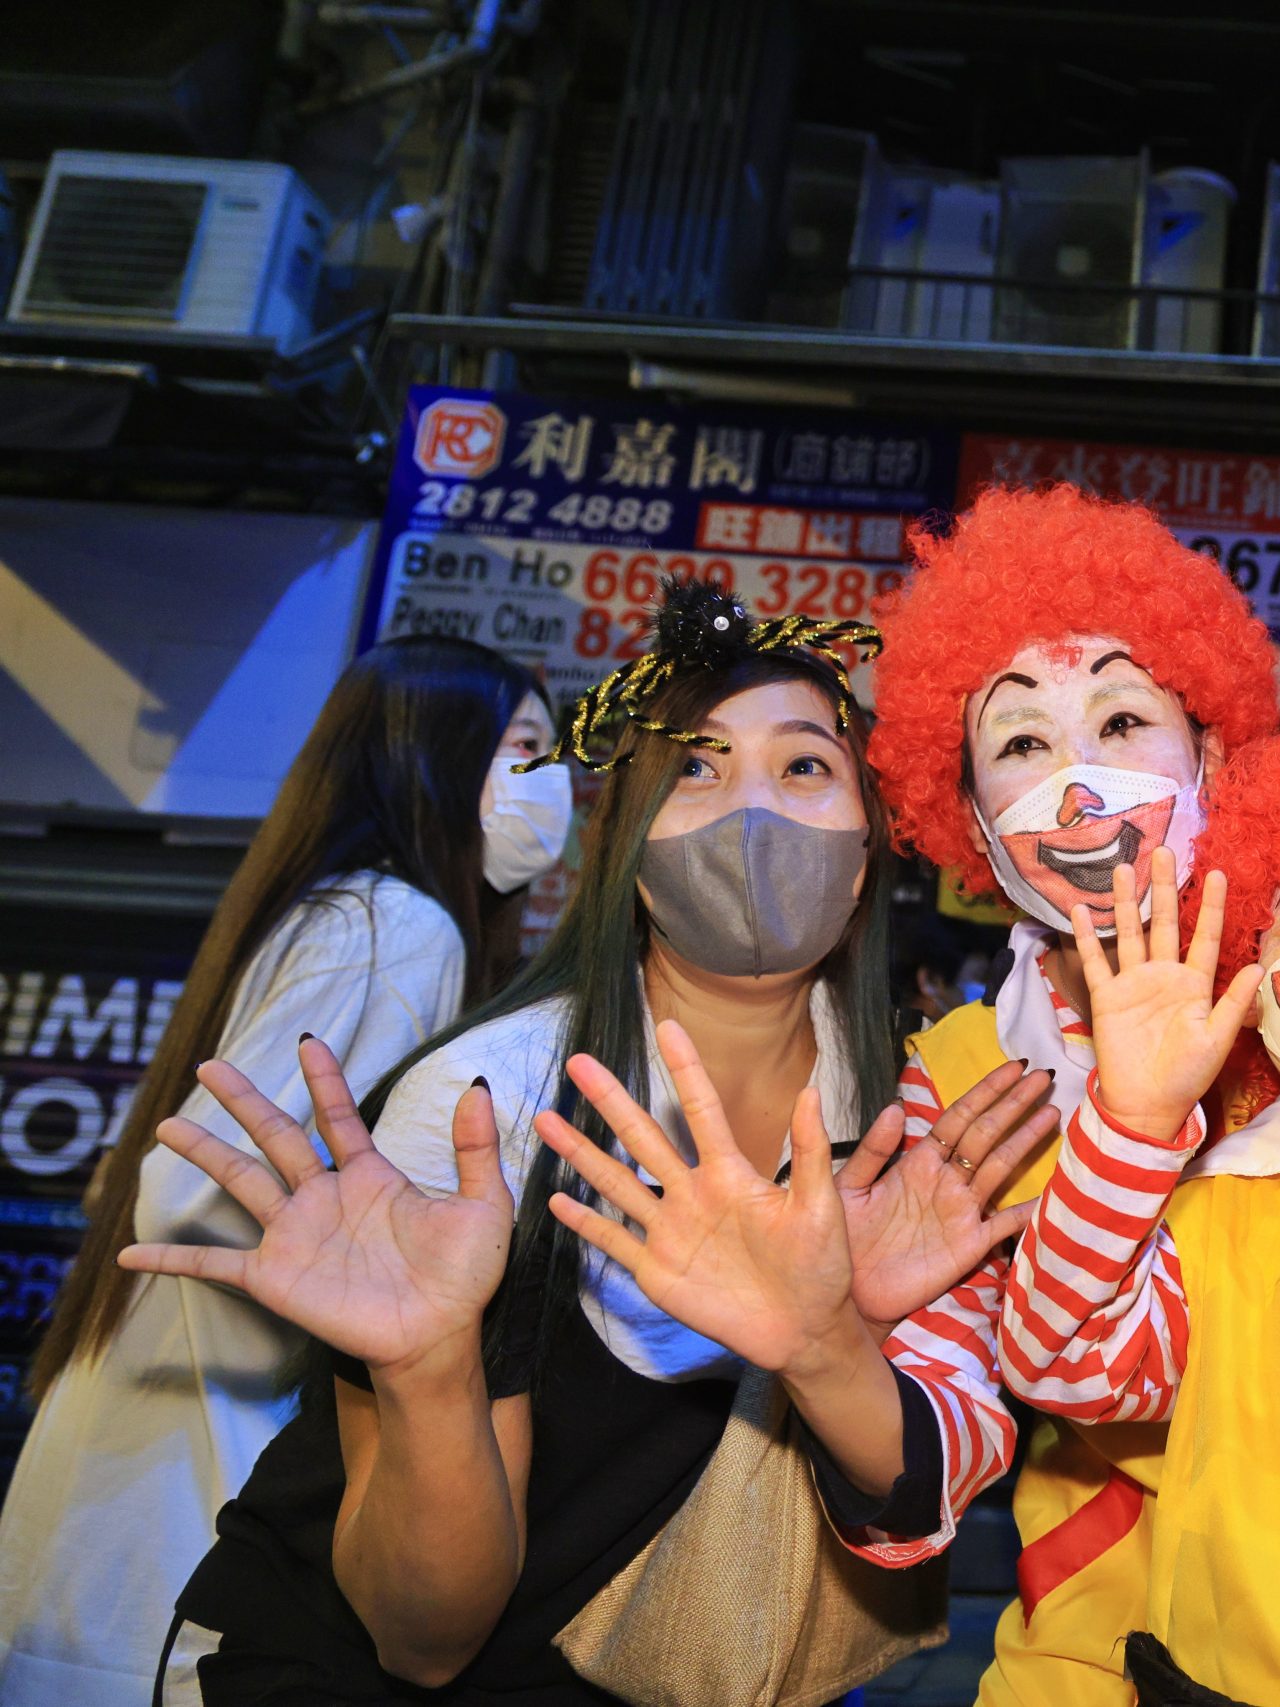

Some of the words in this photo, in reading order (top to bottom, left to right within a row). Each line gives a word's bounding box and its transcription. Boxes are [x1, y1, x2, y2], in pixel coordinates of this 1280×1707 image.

[511, 411, 765, 493] 利嘉閣
[412, 480, 539, 523] 2812
[546, 498, 674, 535] 4888
[404, 540, 490, 578] Ben
[509, 547, 573, 588] Ho
[493, 602, 568, 643] Chan
